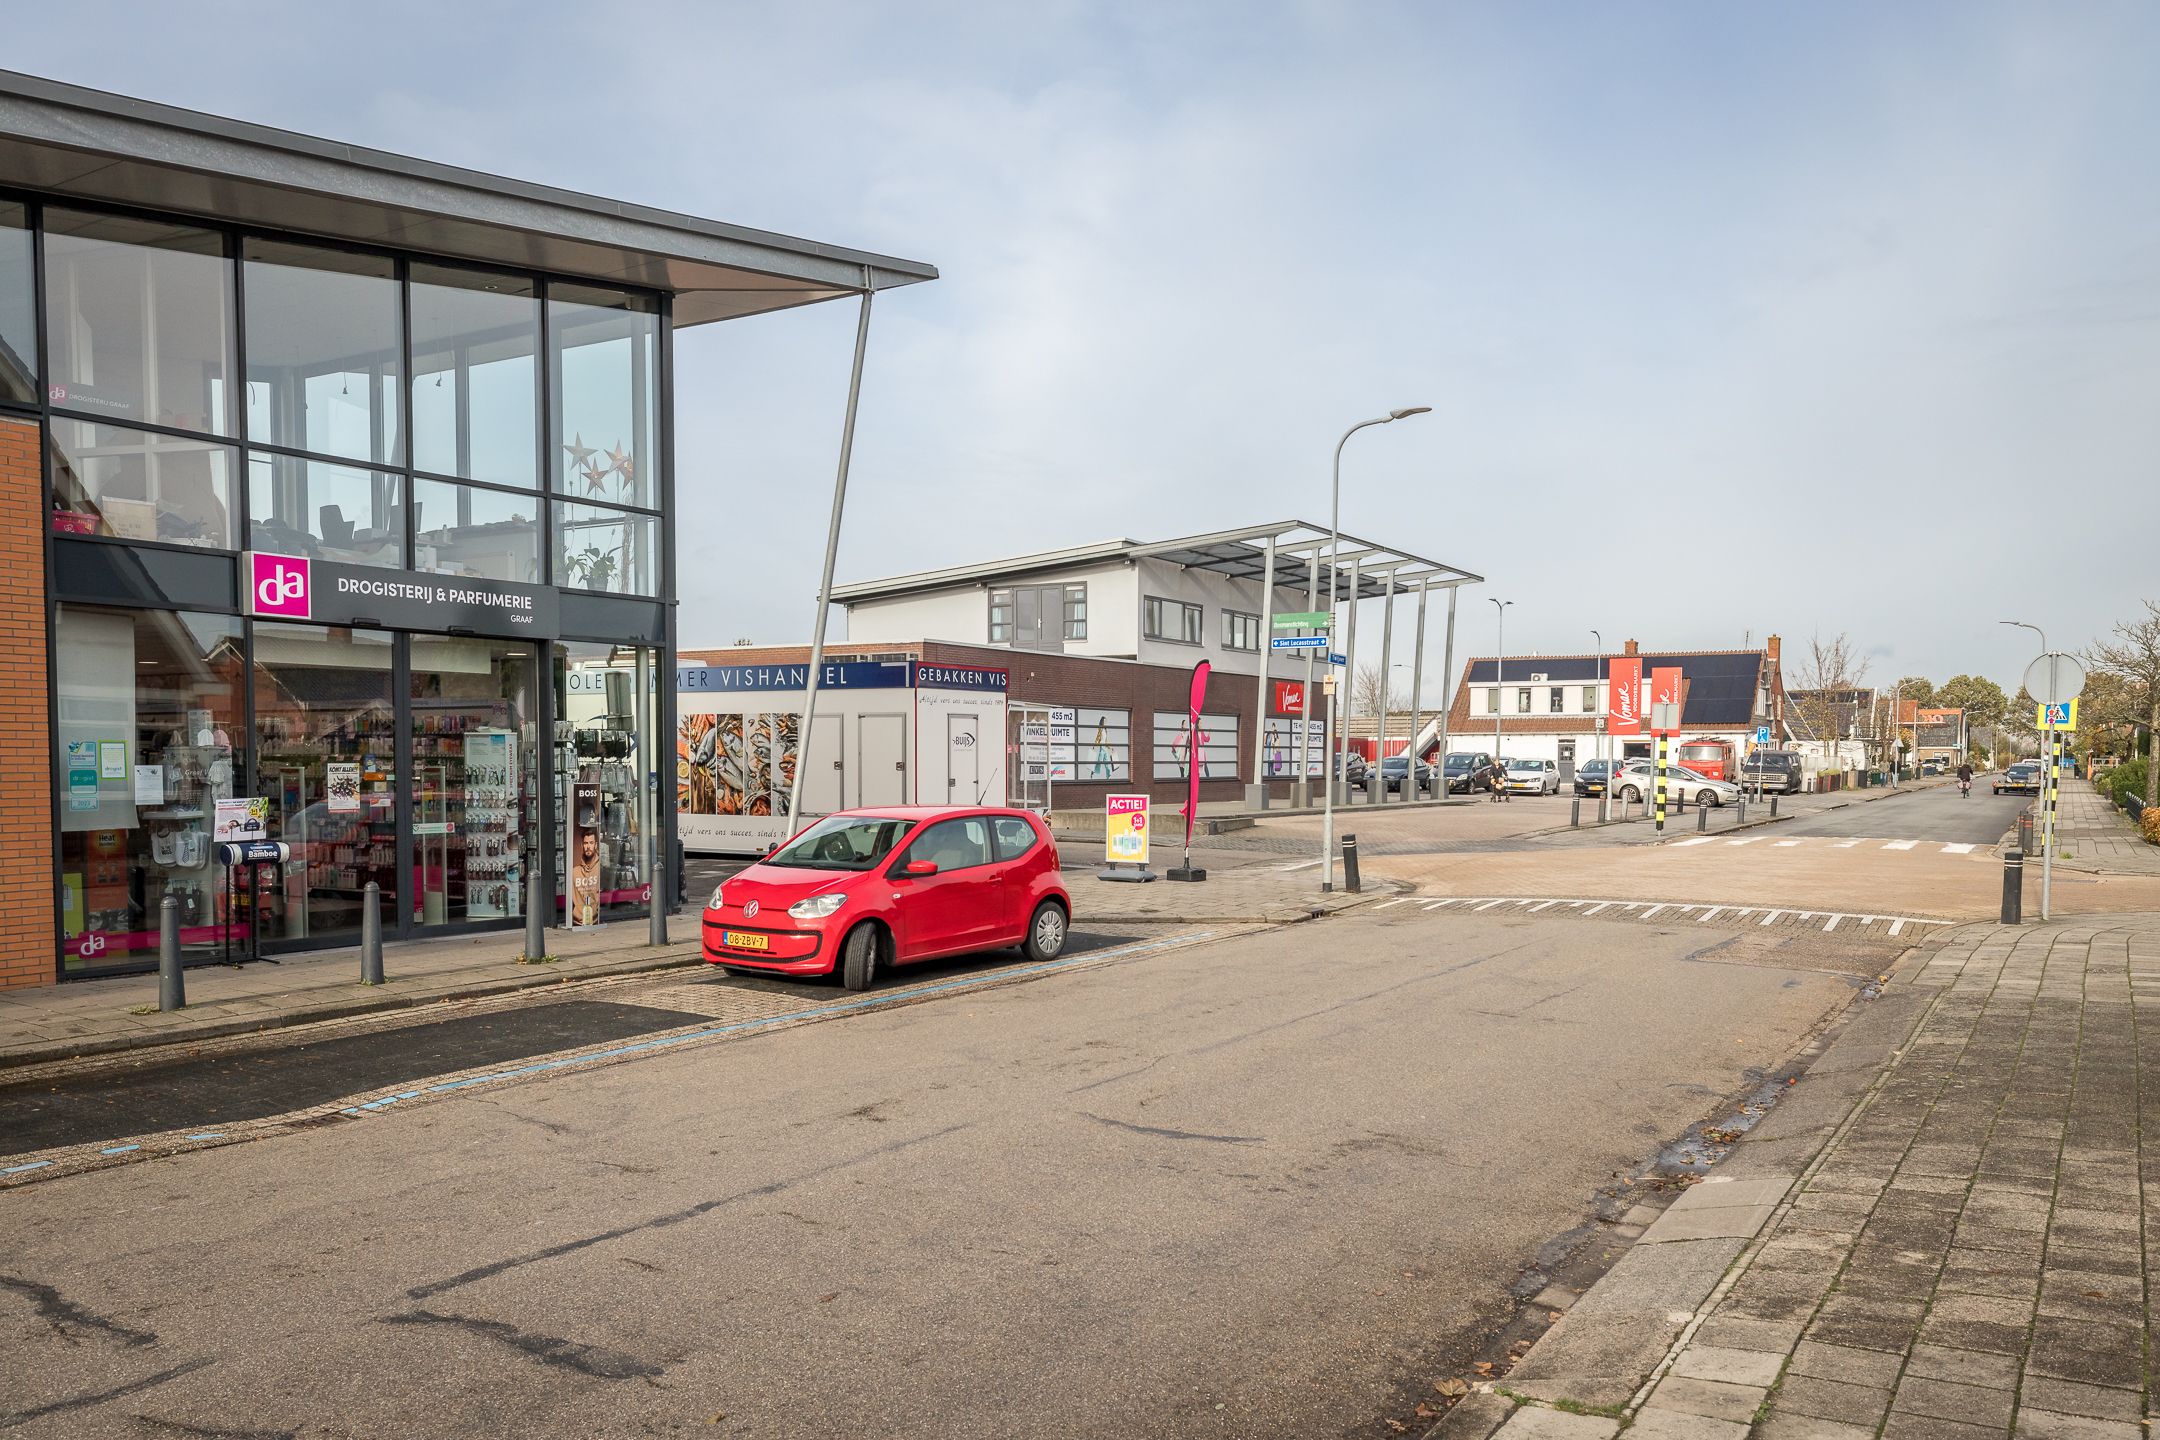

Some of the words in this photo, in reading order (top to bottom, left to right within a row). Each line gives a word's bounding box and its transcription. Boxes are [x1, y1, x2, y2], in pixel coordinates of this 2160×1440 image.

[49, 387, 65, 399] da
[69, 394, 108, 406] DROGISTERIJ
[258, 564, 304, 606] da
[338, 578, 432, 604] DROGISTERIJ
[436, 588, 446, 602] &
[449, 589, 532, 610] PARFUMERIE
[510, 614, 533, 624] GRAAF
[720, 667, 847, 687] VISHANEL
[918, 667, 982, 684] GEBAKKEN
[989, 672, 1007, 686] VIS
[1610, 681, 1639, 726] Vomar
[1051, 711, 1063, 721] 455
[1063, 712, 1073, 721] m2
[578, 789, 597, 798] BOSS
[1110, 800, 1143, 810] ACTIE!
[99, 833, 116, 842] Heat
[757, 828, 777, 838] sinds
[248, 850, 278, 858] Bamboe
[575, 875, 598, 888] BOSS
[642, 885, 651, 901] d
[80, 934, 105, 956] da
[729, 934, 764, 947] 08-ZBV-7
